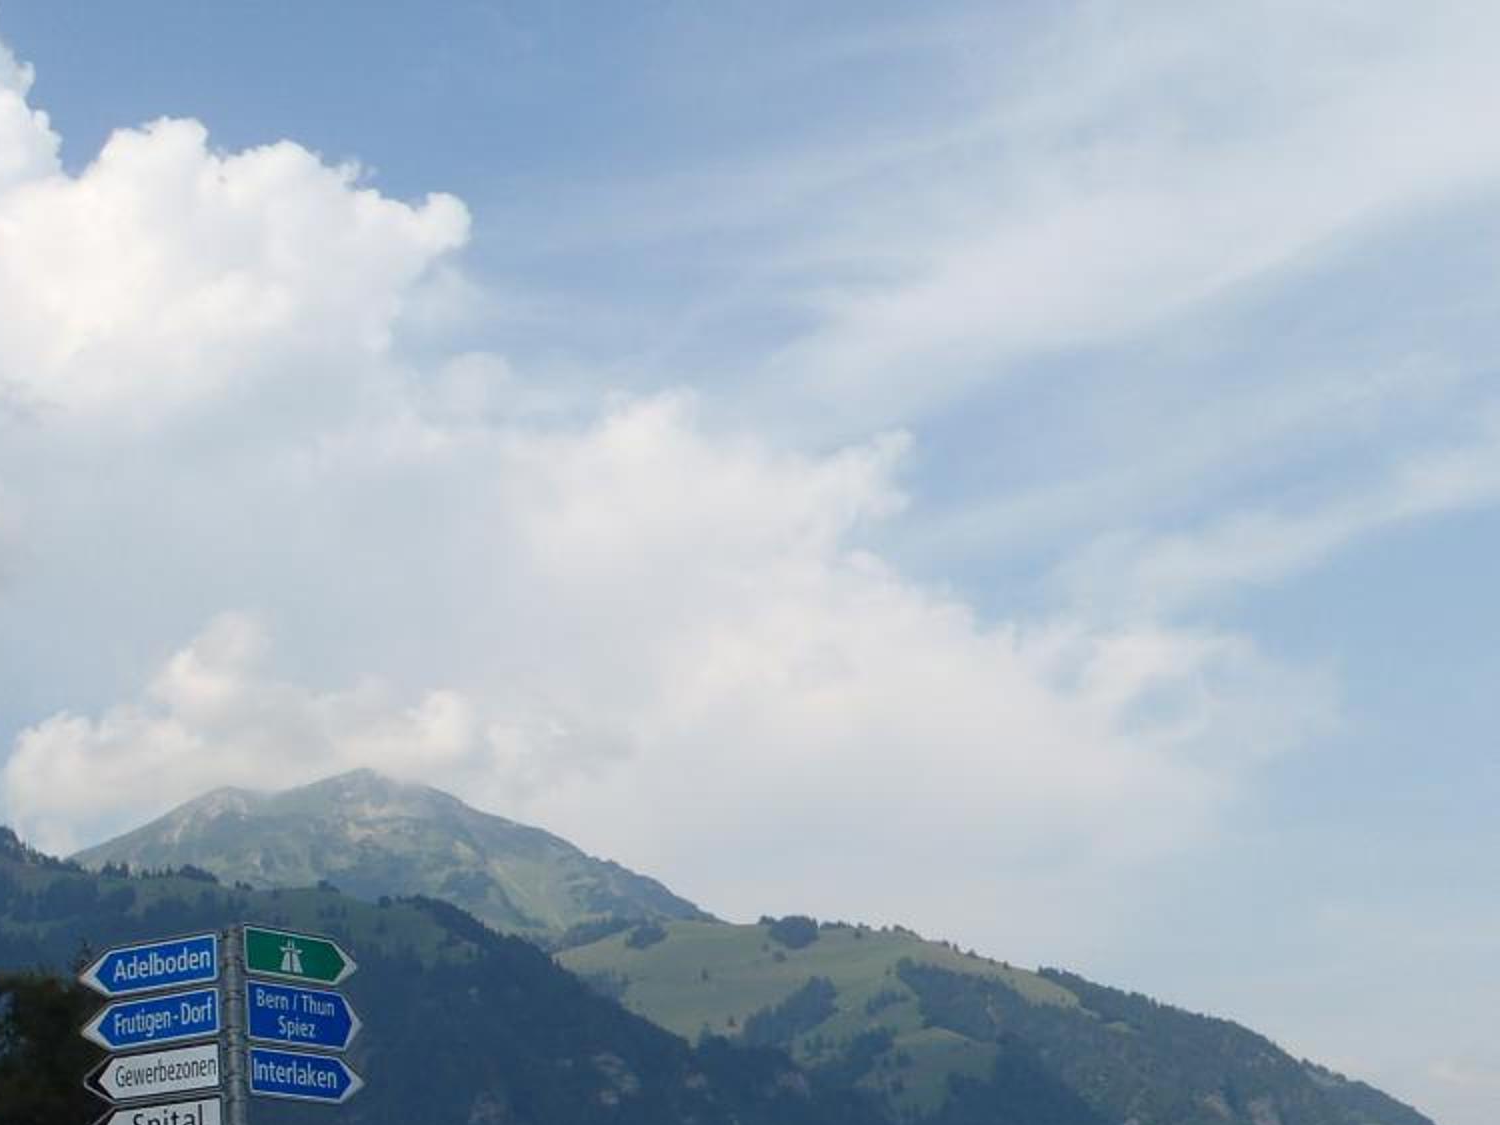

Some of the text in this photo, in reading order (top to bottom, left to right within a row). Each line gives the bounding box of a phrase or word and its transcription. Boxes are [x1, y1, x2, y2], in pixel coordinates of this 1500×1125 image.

[113, 947, 211, 983] Adelboden
[256, 988, 289, 1010] Bern
[301, 995, 335, 1017] Thun
[277, 1015, 317, 1040] Spiez
[115, 1058, 217, 1088] Gewerbezonen
[253, 1058, 337, 1089] Interlaken
